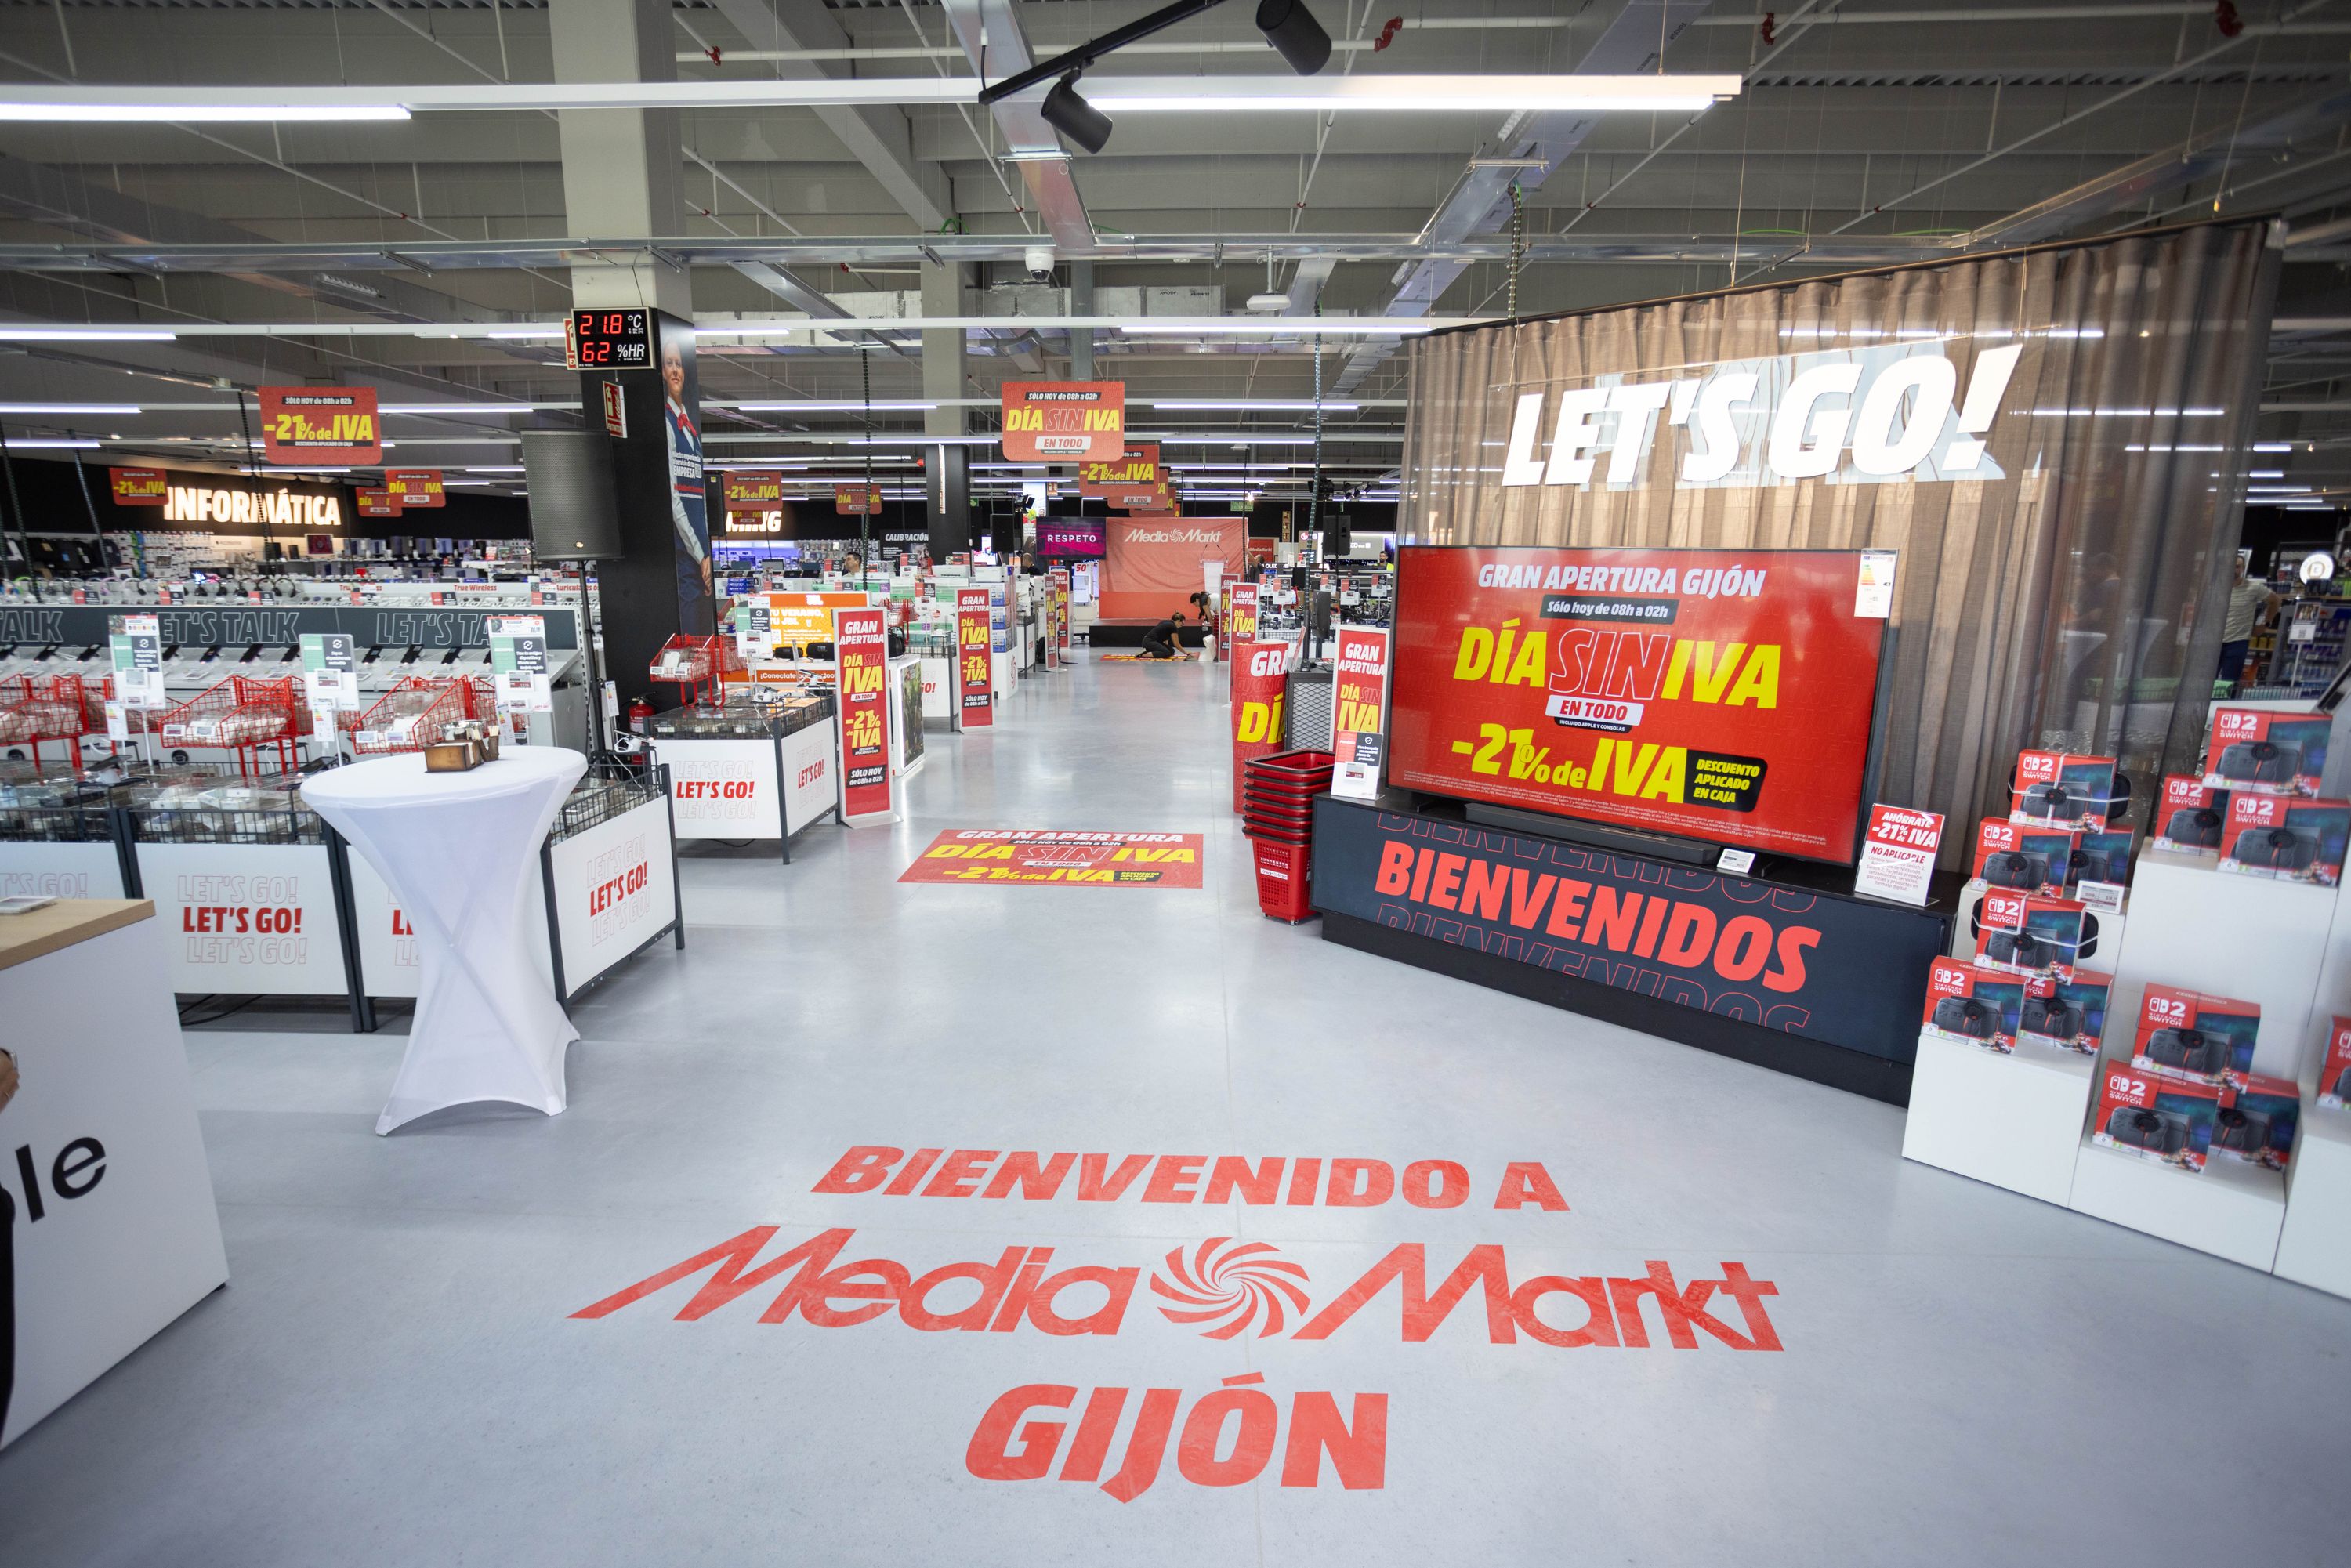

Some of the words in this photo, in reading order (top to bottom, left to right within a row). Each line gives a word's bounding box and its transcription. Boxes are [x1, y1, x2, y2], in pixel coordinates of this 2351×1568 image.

[582, 342, 610, 362] 62
[617, 344, 645, 357] %HR
[1006, 405, 1044, 431] DÍA
[1045, 408, 1085, 432] SIN
[1084, 409, 1120, 431] IVA
[1502, 375, 1759, 487] LET'S
[1768, 342, 2023, 480] GO!
[263, 414, 316, 440] -21%
[317, 427, 332, 440] de
[332, 415, 374, 440] IVA
[1044, 438, 1058, 447] EN
[1058, 438, 1083, 447] TODO
[1080, 463, 1114, 480] -21%
[1114, 472, 1125, 480] de
[1125, 463, 1154, 480] IVA
[146, 481, 166, 494] IVA
[389, 480, 407, 493] DÍA
[425, 483, 442, 493] IVA
[759, 485, 779, 498] IVA
[164, 487, 341, 526] INFORMÁTICA
[838, 494, 852, 503] DÍA
[885, 533, 929, 541] CALIBRACIÓN
[1047, 534, 1096, 543] RESPETO
[1124, 528, 1168, 543] Media
[1181, 528, 1222, 543] Markt
[1478, 564, 1545, 589] GRAN
[1544, 565, 1676, 593] APERTURA
[1682, 564, 1766, 599] GIJÓN
[958, 604, 990, 613] APERTURA
[962, 596, 984, 605] GRAN
[1547, 600, 1570, 614] Sólo
[1571, 602, 1594, 617] hoy
[1595, 603, 1609, 615] de
[1610, 603, 1634, 617] 08h
[1635, 607, 1643, 617] a
[1644, 606, 1668, 618] 02h
[1234, 608, 1244, 617] DÍA
[222, 611, 300, 643] TALK
[376, 613, 455, 646] LET'S
[845, 621, 878, 634] GRAN
[961, 617, 975, 627] DÍA
[1233, 617, 1255, 633] IVA
[839, 634, 884, 645] APERTURA
[960, 626, 988, 645] IVA
[1345, 643, 1379, 660] GRAN
[843, 654, 863, 668] DÍA
[864, 653, 882, 666] SIN
[962, 655, 987, 669] -21%
[1339, 659, 1385, 676] APERTURA
[1454, 617, 1547, 687] DÍA
[1549, 628, 1671, 701] SIN
[1661, 639, 1782, 709] IVA
[843, 665, 883, 694] IVA
[966, 668, 987, 681] IVA
[1340, 683, 1360, 701] DÍA
[1360, 686, 1382, 704] SIN
[1337, 701, 1379, 733] IVA
[1559, 700, 1582, 716] EN
[1585, 702, 1628, 721] TODO
[846, 709, 881, 730] -21%
[852, 727, 881, 748] IVA
[1451, 723, 1550, 784] -21%
[1552, 759, 1588, 788] de
[1587, 737, 1688, 803] IVA
[1696, 759, 1761, 777] DESCUENTO
[851, 769, 868, 778] SÓLO
[868, 767, 883, 777] HOY
[676, 781, 720, 798] LET'S
[723, 781, 755, 798] GO!
[1694, 773, 1750, 791] APLICADO
[1693, 787, 1714, 800] EN
[1714, 788, 1736, 803] CAJA
[1882, 812, 1932, 828] AHÓRRATE
[956, 831, 1039, 840] GRAN
[1040, 831, 1183, 842] APERTURA
[1872, 822, 1908, 840] -21%
[1907, 828, 1937, 847] IVA
[924, 843, 1016, 860] DÍA
[1018, 846, 1112, 861] SIN
[1110, 848, 1195, 863] IVA
[1871, 846, 1882, 855] NO
[1983, 842, 2010, 850] SWITCH
[943, 867, 1020, 880] -21%
[1046, 869, 1115, 882] IVA
[589, 875, 625, 918] LET'S
[627, 860, 648, 896] GO!
[183, 907, 249, 933] LET'S
[255, 907, 302, 934] GO!
[1375, 841, 1822, 993] BIENVENIDOS
[1987, 915, 2018, 925] SWITCH
[1934, 986, 1963, 995] SWITCH
[2109, 1094, 2142, 1106] SWITCH
[812, 1146, 1470, 1210] BIENVENIDO
[1494, 1162, 1570, 1212] A
[567, 1225, 1142, 1337] Media
[1291, 1242, 1784, 1352] Markt
[965, 1371, 1389, 1502] GIJÓN
